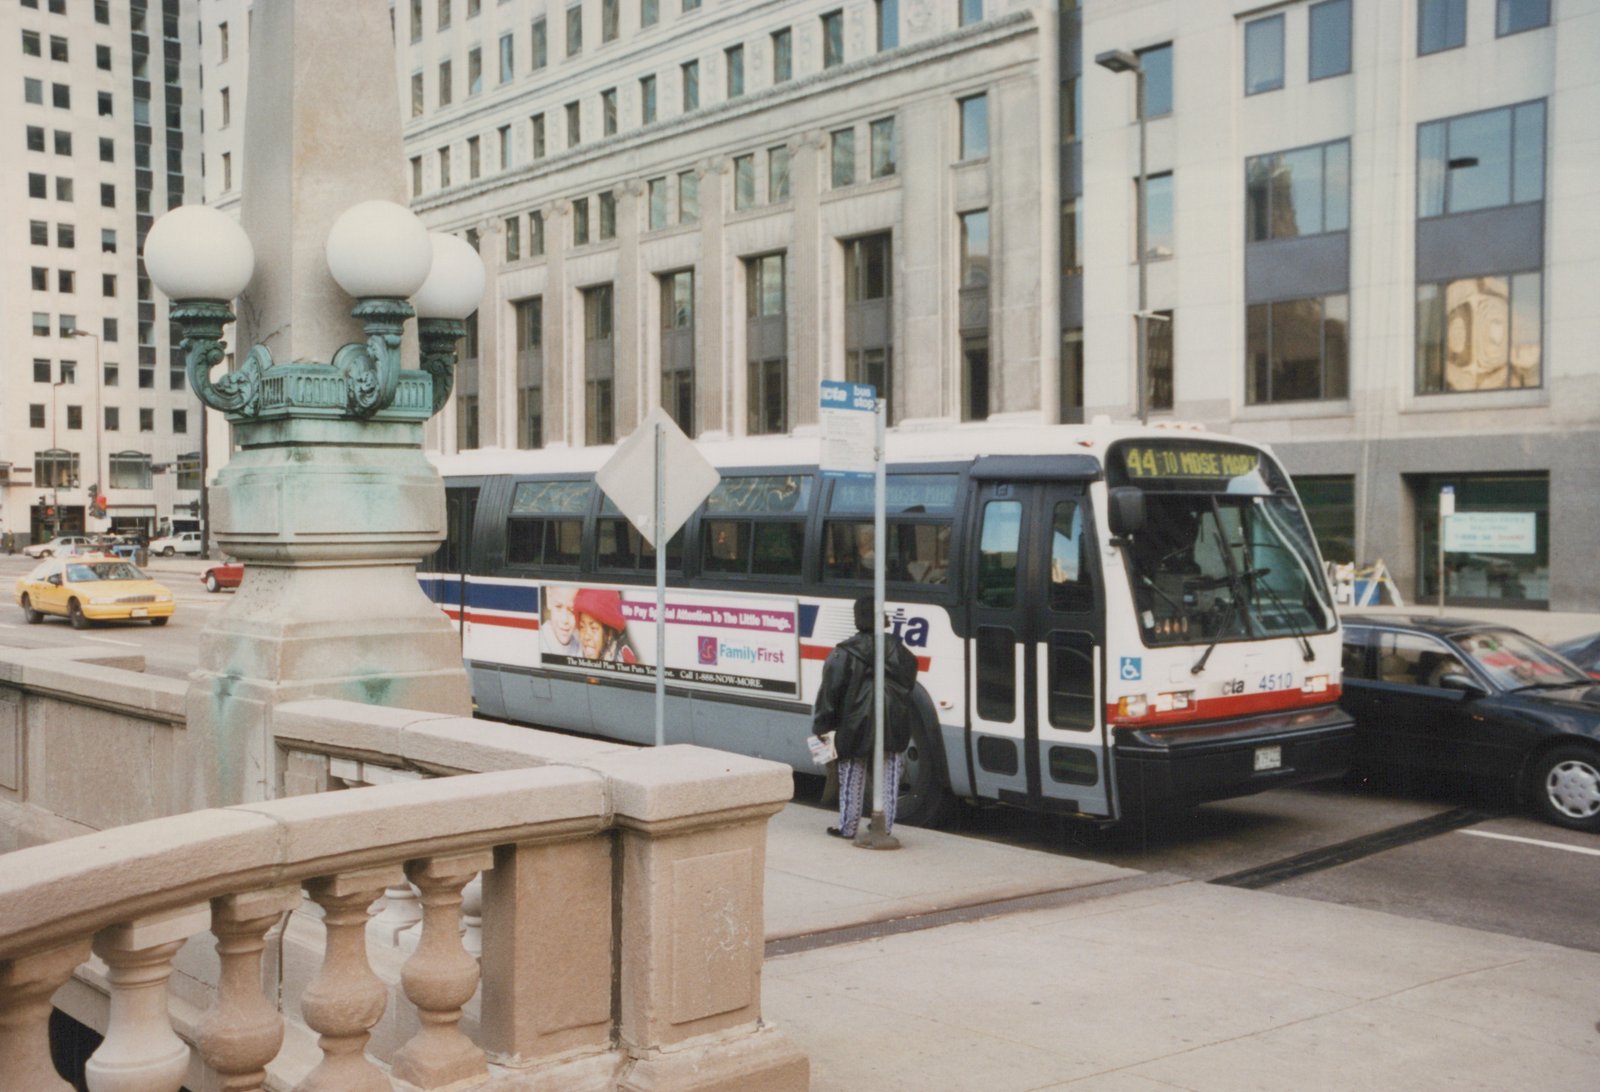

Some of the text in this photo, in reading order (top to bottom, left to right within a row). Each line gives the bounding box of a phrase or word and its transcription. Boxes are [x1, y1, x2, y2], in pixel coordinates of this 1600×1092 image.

[853, 385, 871, 397] bus
[853, 397, 874, 410] stop
[1127, 448, 1158, 476] 44
[1163, 451, 1178, 474] TO
[1180, 452, 1220, 475] MDSE
[622, 605, 632, 616] We
[634, 605, 648, 619] Pay
[677, 609, 711, 622] Attention
[713, 612, 722, 623] To
[724, 613, 737, 624] The
[739, 613, 761, 626] Little
[891, 608, 930, 648] ta
[568, 657, 577, 665] The
[579, 659, 602, 668] Medicaid
[604, 662, 615, 670] Plan
[617, 663, 630, 672] That
[632, 665, 644, 673] Puts
[680, 671, 693, 680] Call
[1222, 672, 1293, 695] cta 4510
